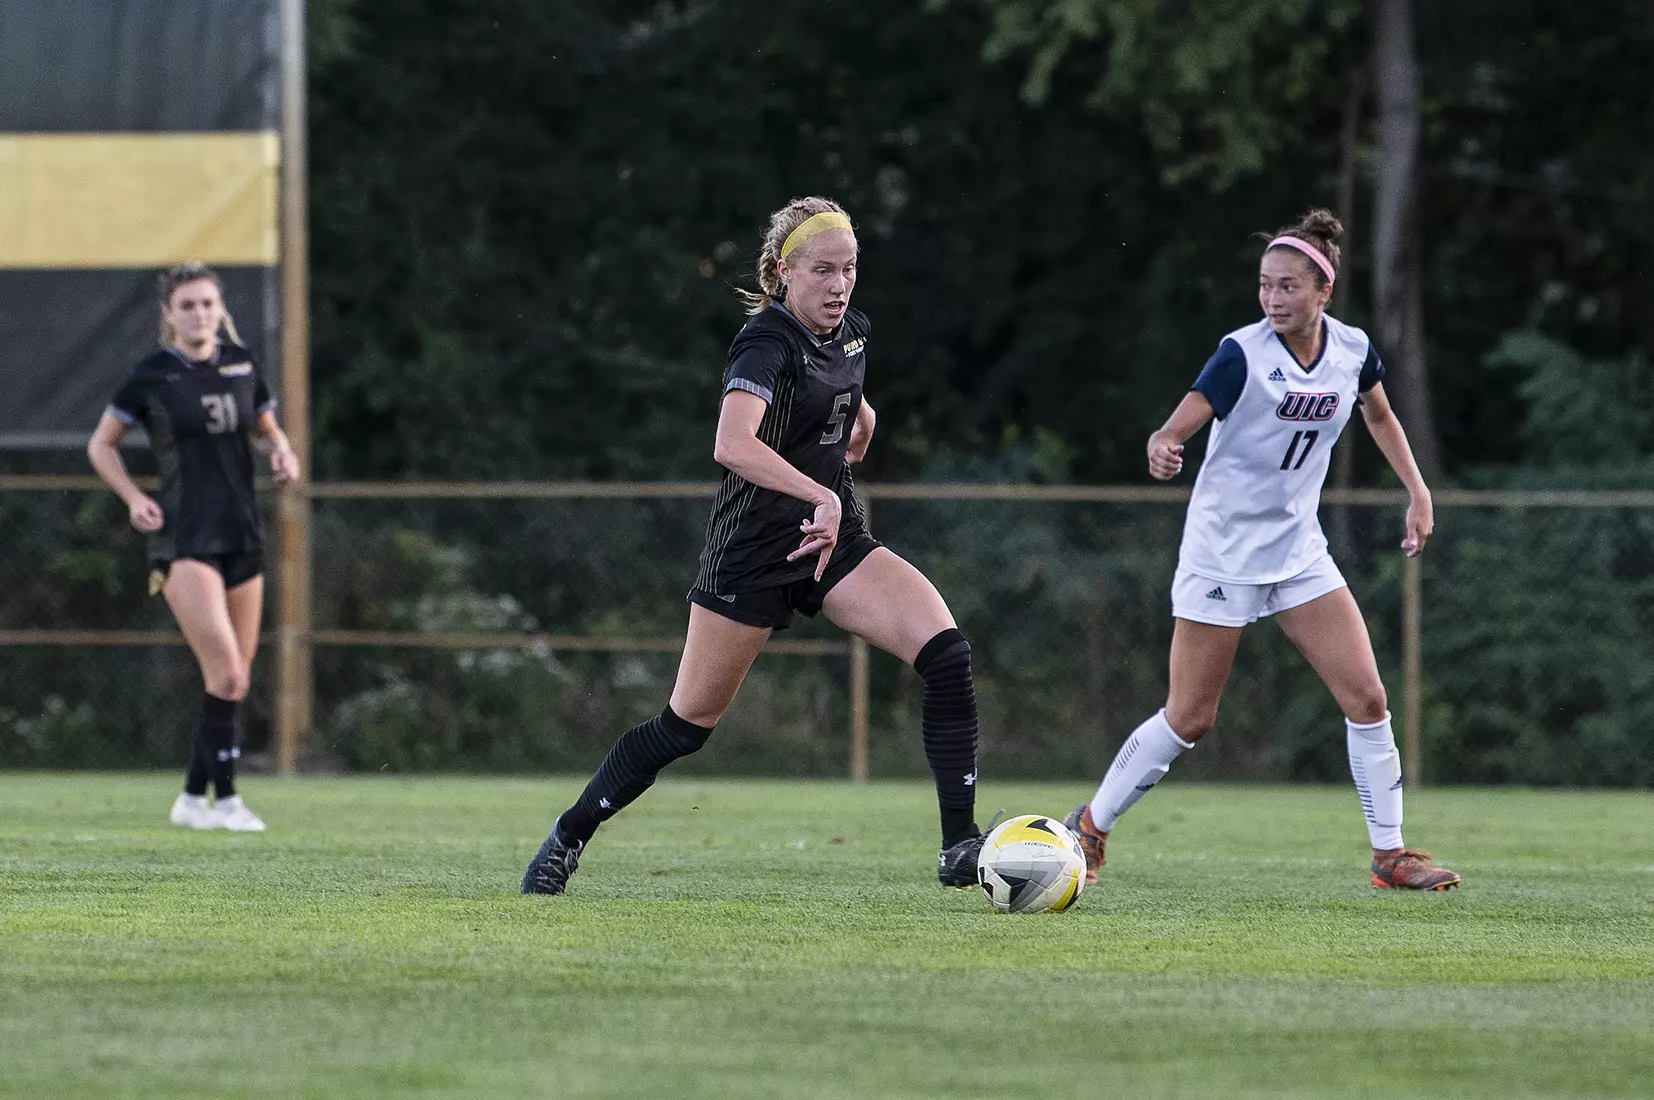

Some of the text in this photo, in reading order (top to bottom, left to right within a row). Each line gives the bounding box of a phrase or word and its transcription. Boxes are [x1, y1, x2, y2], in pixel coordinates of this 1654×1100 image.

[201, 394, 239, 434] 31
[819, 392, 851, 445] 5
[1276, 391, 1340, 421] UIC
[1279, 430, 1319, 470] 17
